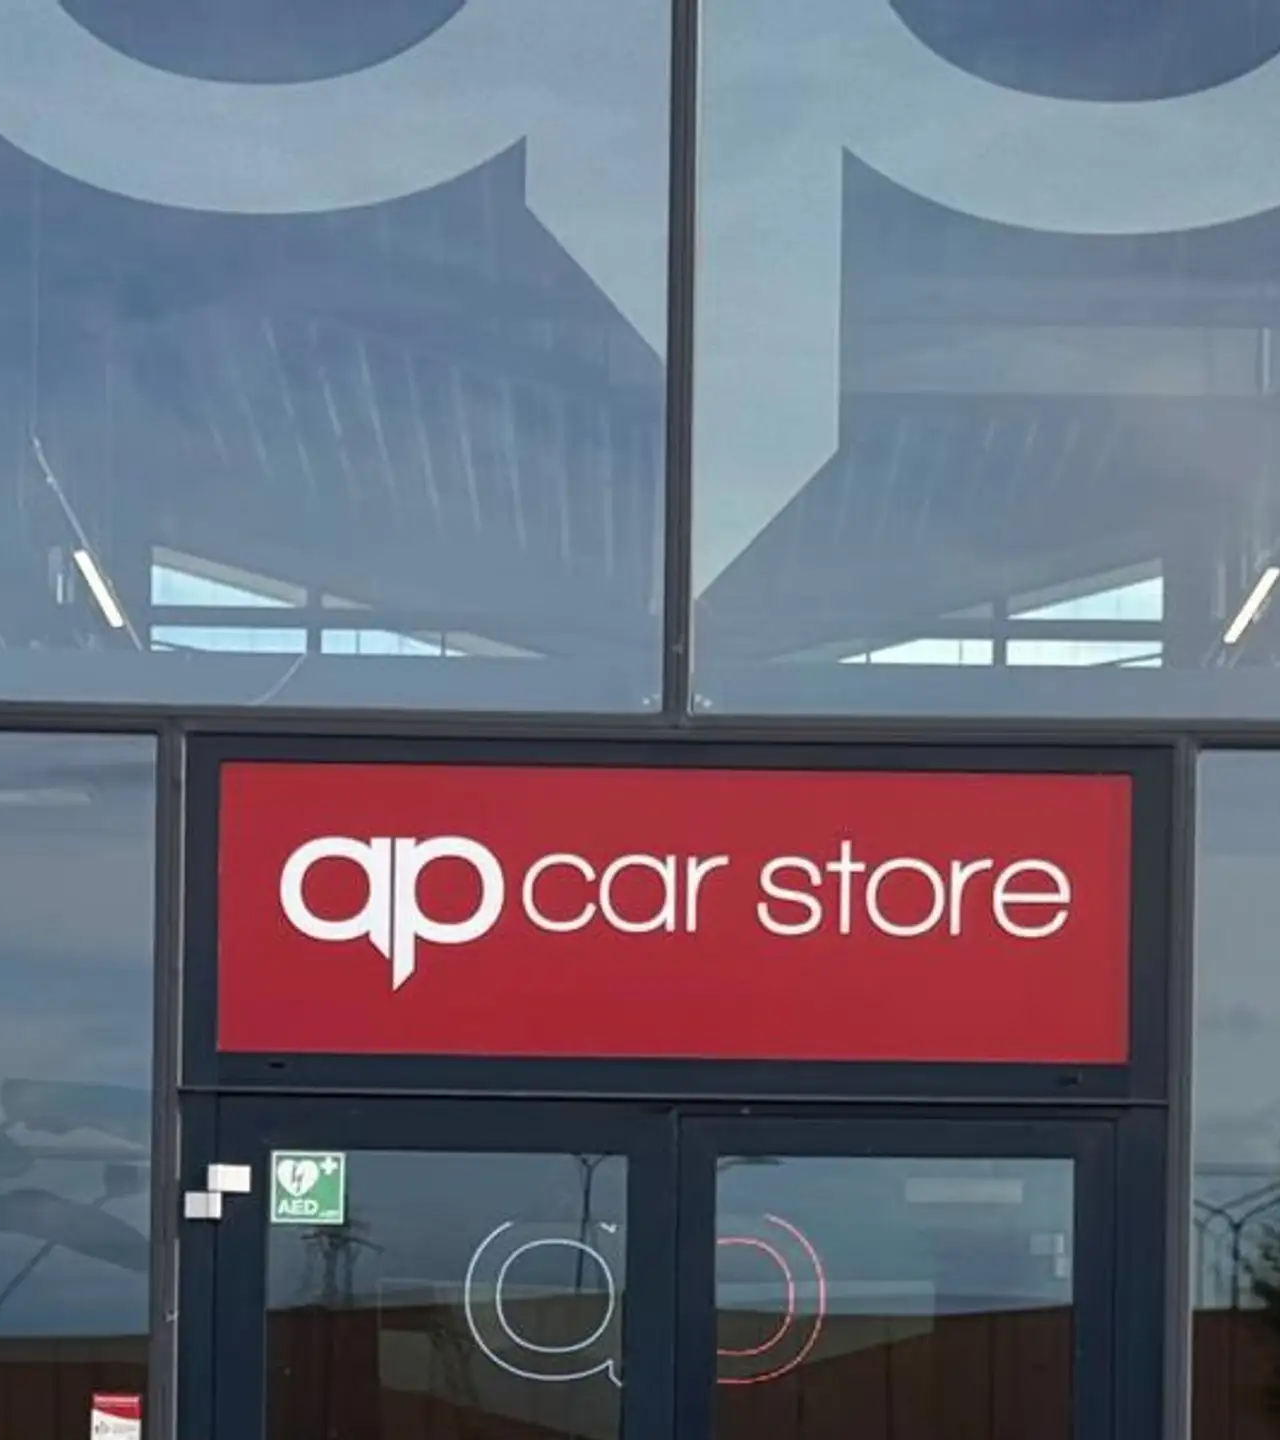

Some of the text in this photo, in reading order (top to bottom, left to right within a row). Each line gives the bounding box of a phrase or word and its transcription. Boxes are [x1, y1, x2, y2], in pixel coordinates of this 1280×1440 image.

[281, 837, 1071, 990] ap car store
[277, 1200, 319, 1216] AED
